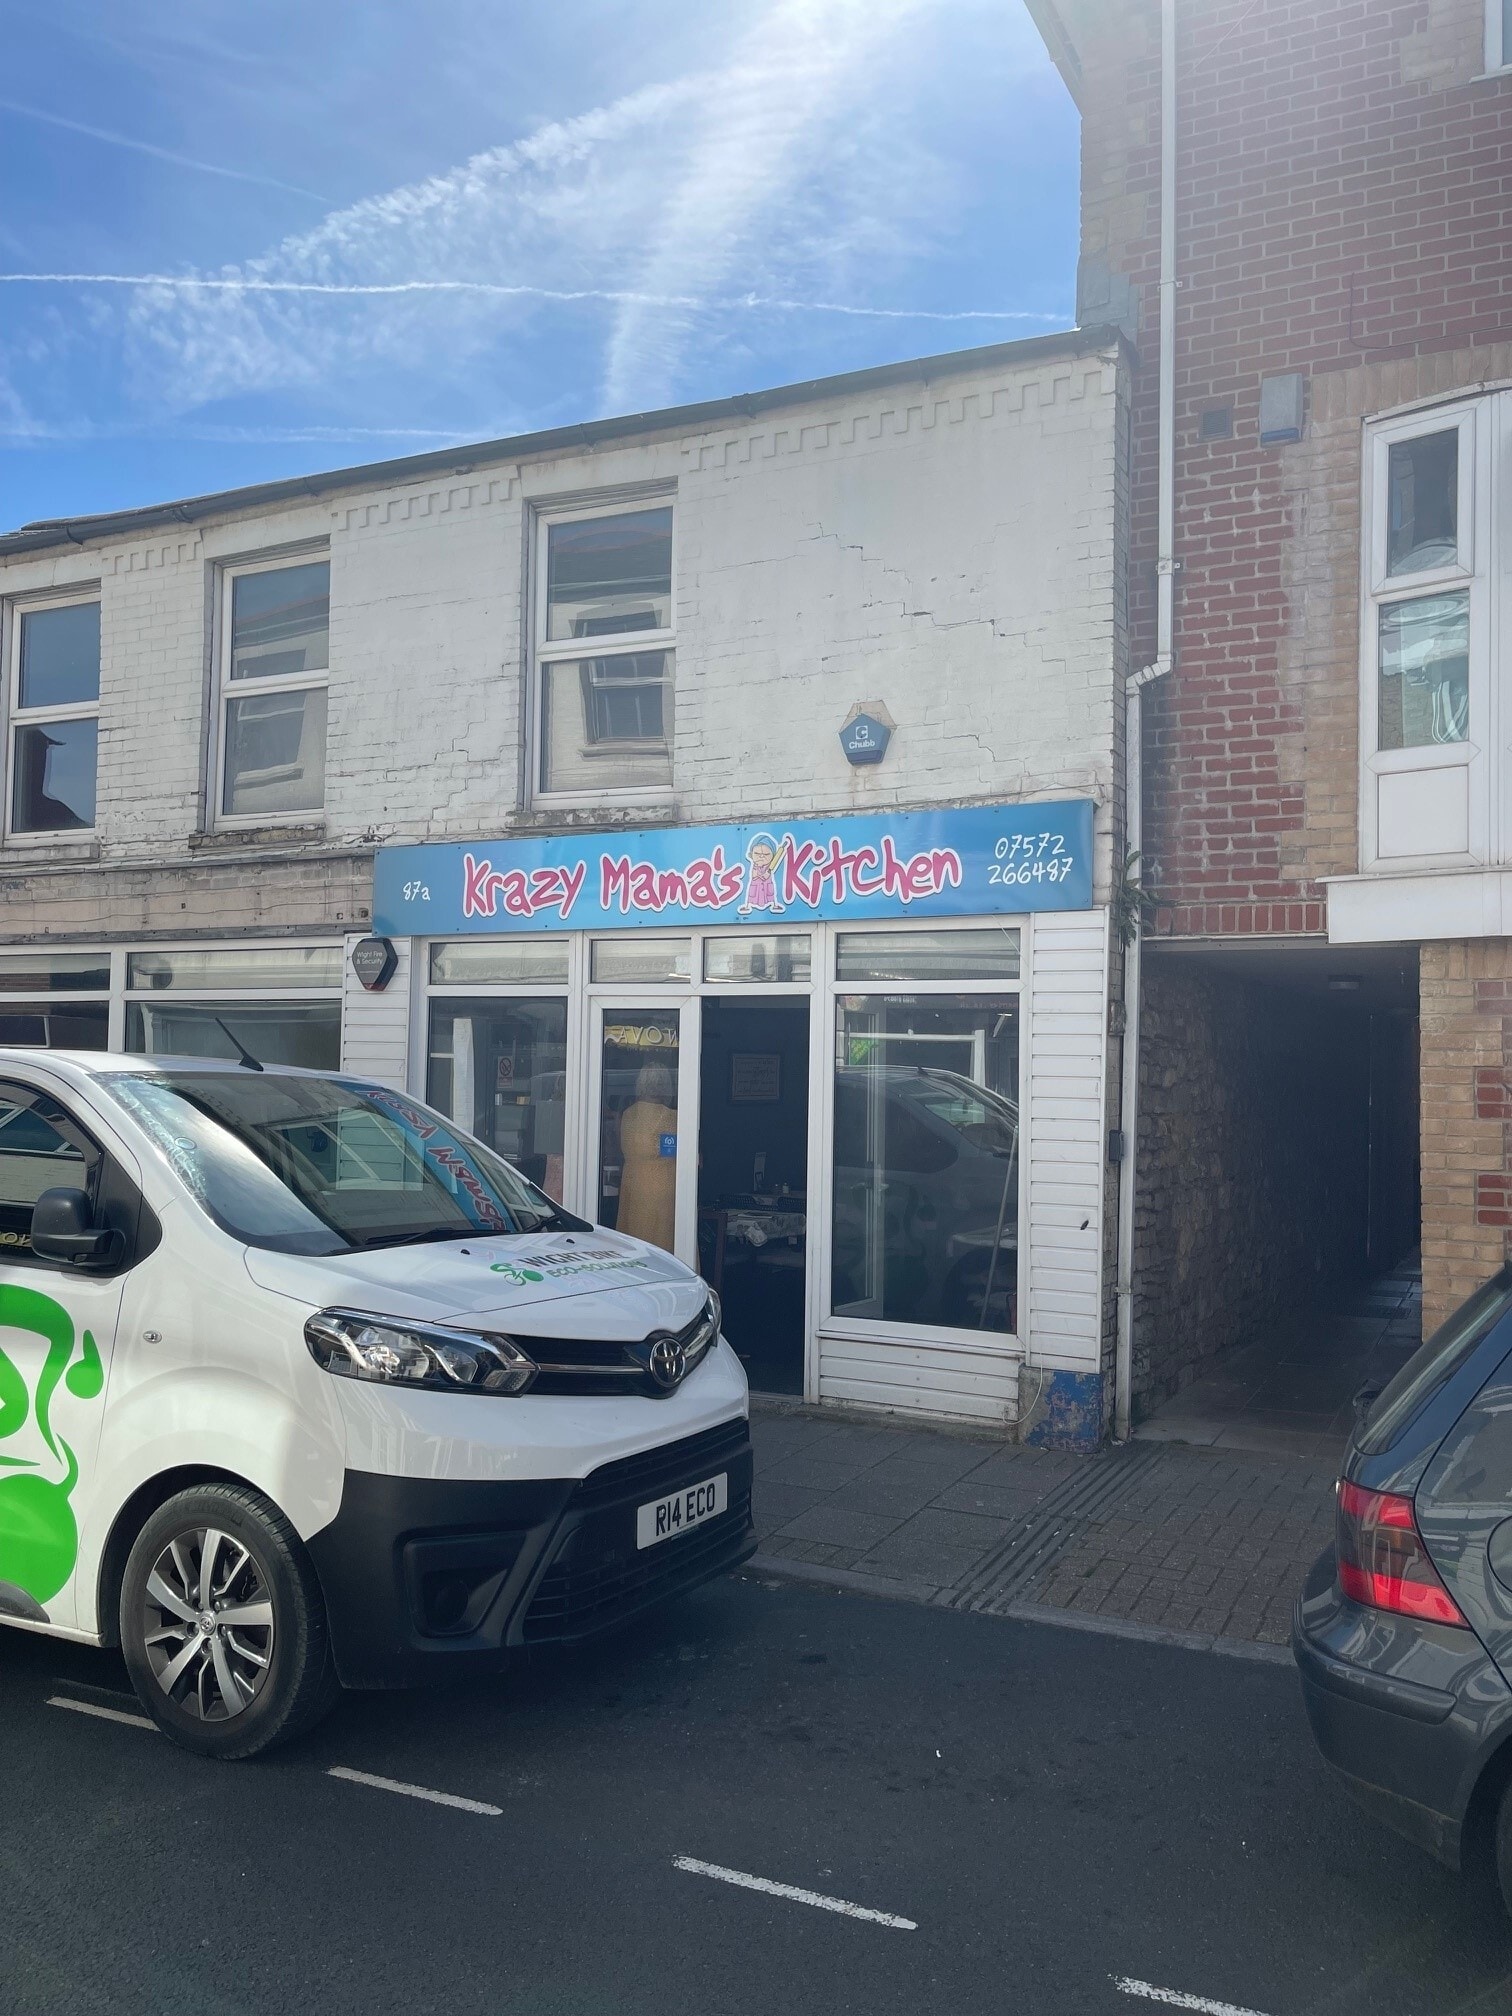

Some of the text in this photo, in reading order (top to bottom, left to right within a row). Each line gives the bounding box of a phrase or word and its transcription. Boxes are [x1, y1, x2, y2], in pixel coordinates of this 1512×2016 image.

[848, 739, 876, 750] Chubb
[994, 832, 1066, 860] 07572
[402, 831, 963, 920] 87a Krazy Mama's Kitchen
[987, 858, 1074, 886] 266487
[655, 1482, 716, 1537] R14 ECO
